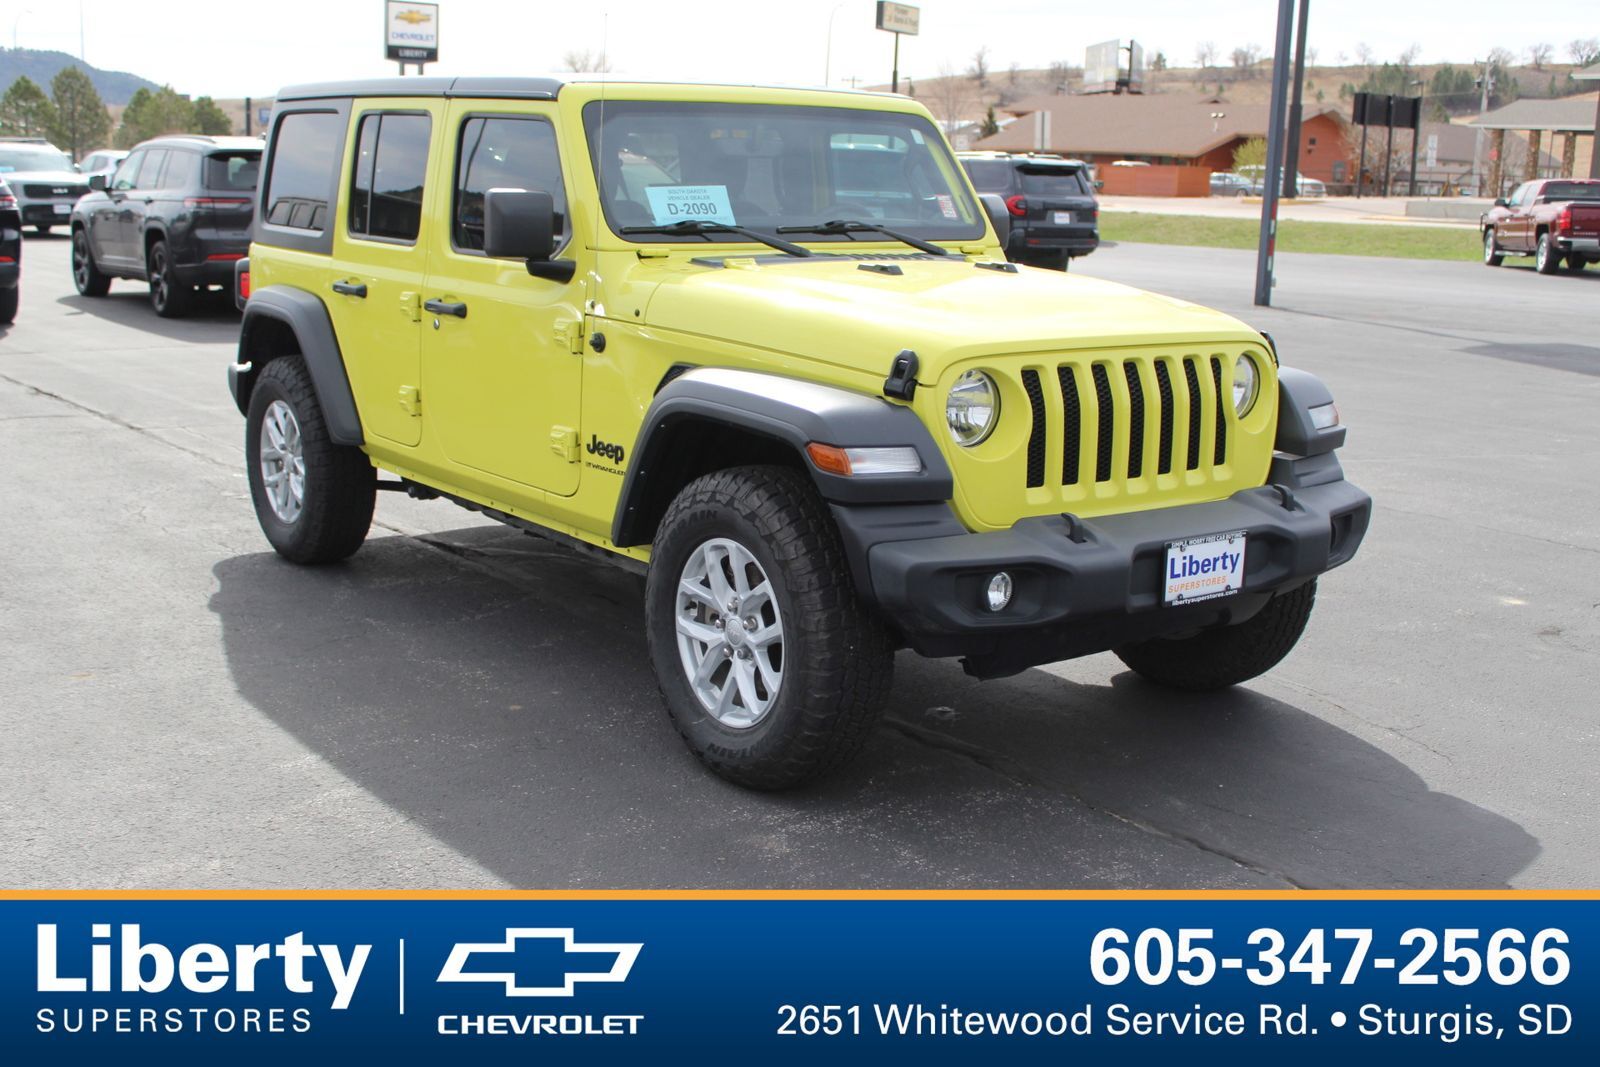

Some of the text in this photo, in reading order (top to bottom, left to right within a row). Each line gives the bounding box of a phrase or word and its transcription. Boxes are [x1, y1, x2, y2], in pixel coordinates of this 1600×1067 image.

[392, 31, 434, 41] CHEVROLET
[398, 48, 427, 58] LIBERTY
[667, 202, 718, 216] D-2090
[586, 433, 625, 466] Jeep
[1169, 551, 1240, 579] Liberty
[1167, 575, 1228, 594] SUPERSTORES
[1171, 589, 1239, 606] libertysuperstores.com
